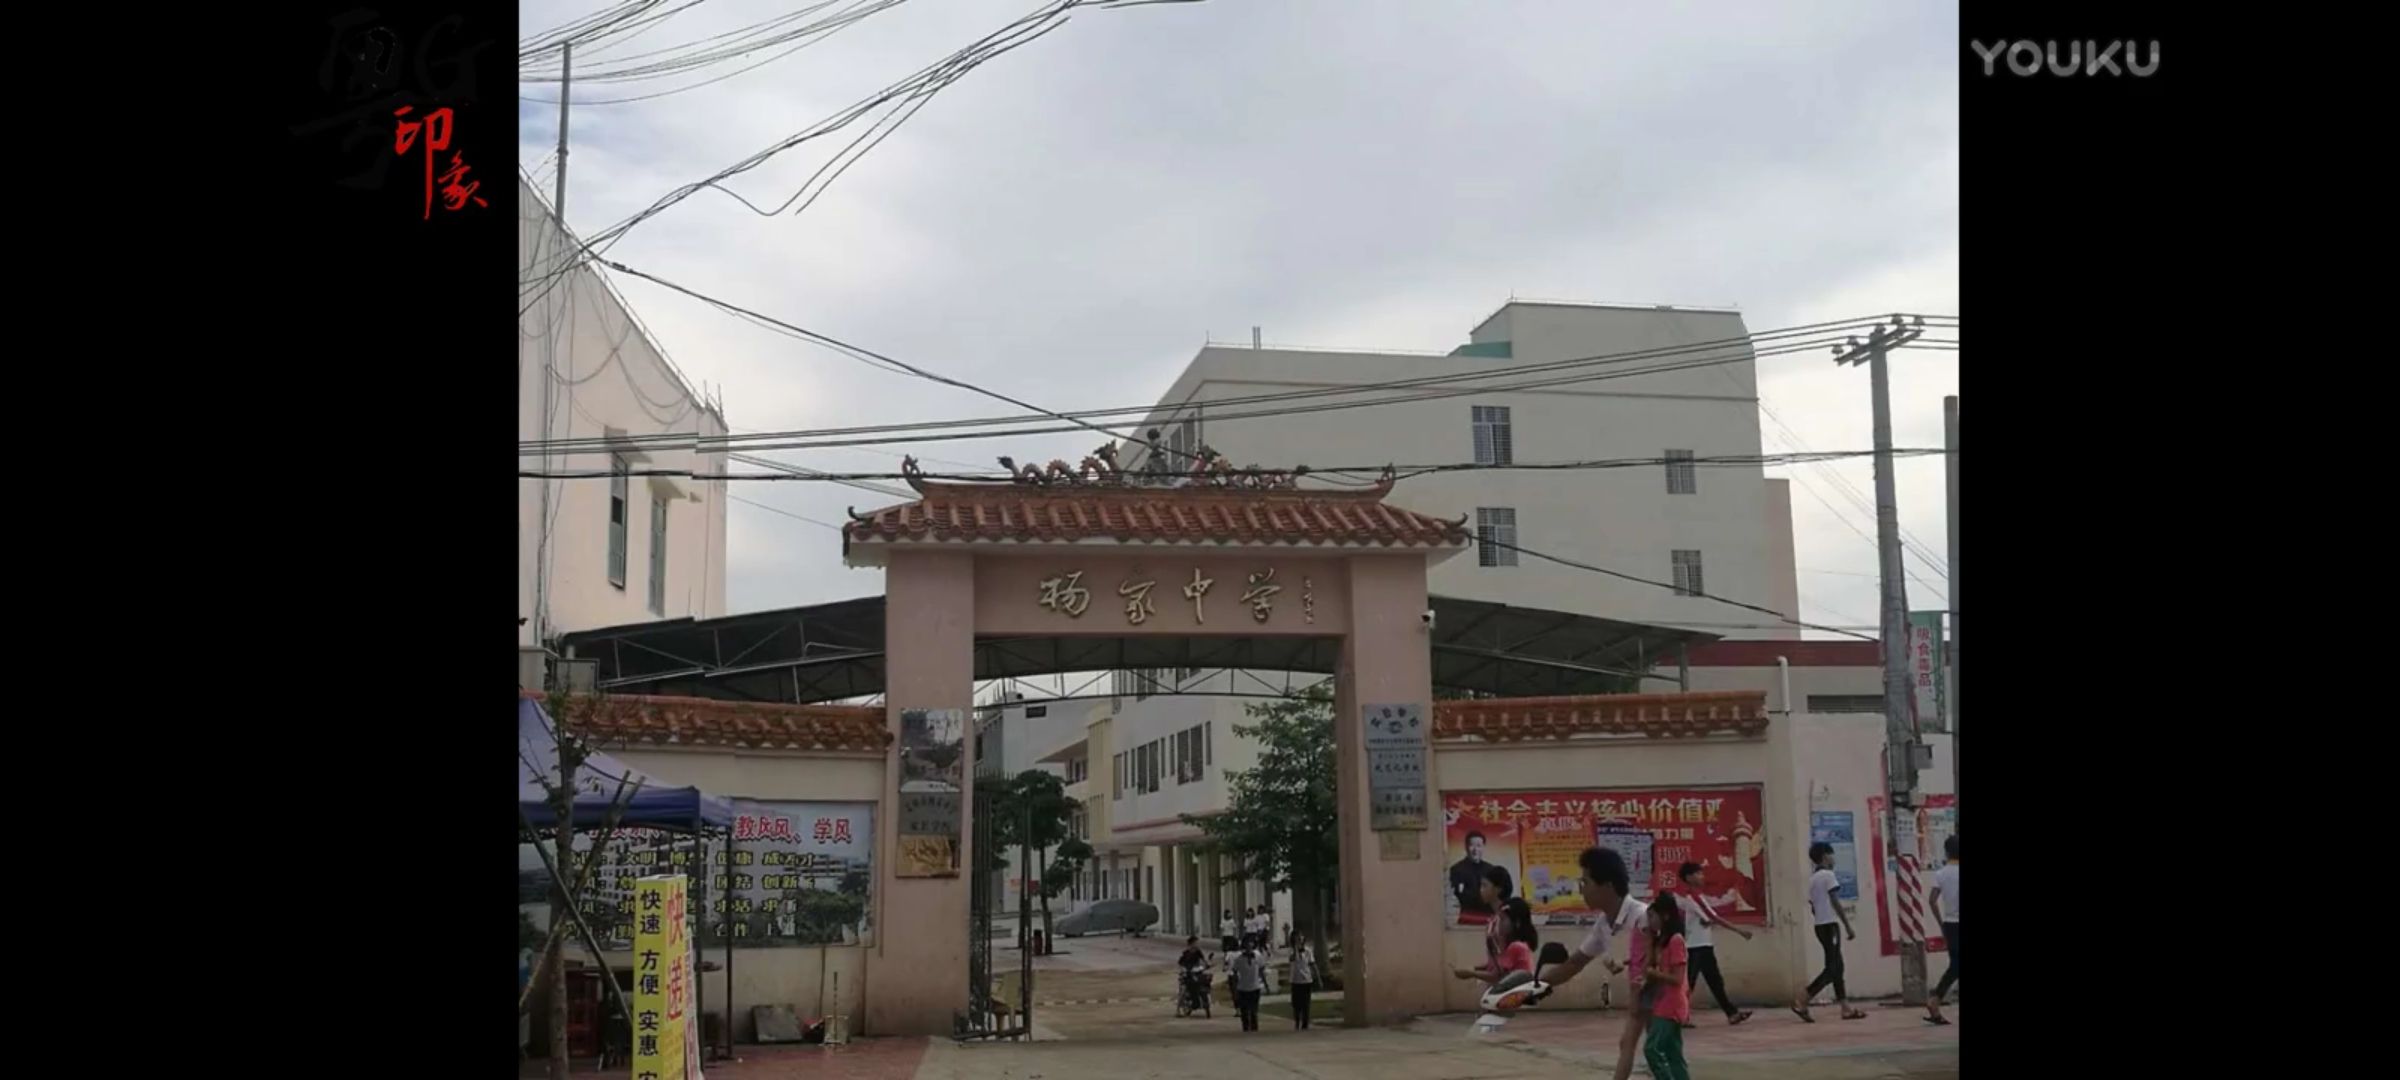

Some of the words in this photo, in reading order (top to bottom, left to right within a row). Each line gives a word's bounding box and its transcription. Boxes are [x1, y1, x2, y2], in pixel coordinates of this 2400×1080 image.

[639, 889, 661, 935] 快速
[639, 949, 661, 995] 方便
[637, 1010, 659, 1056] 实惠
